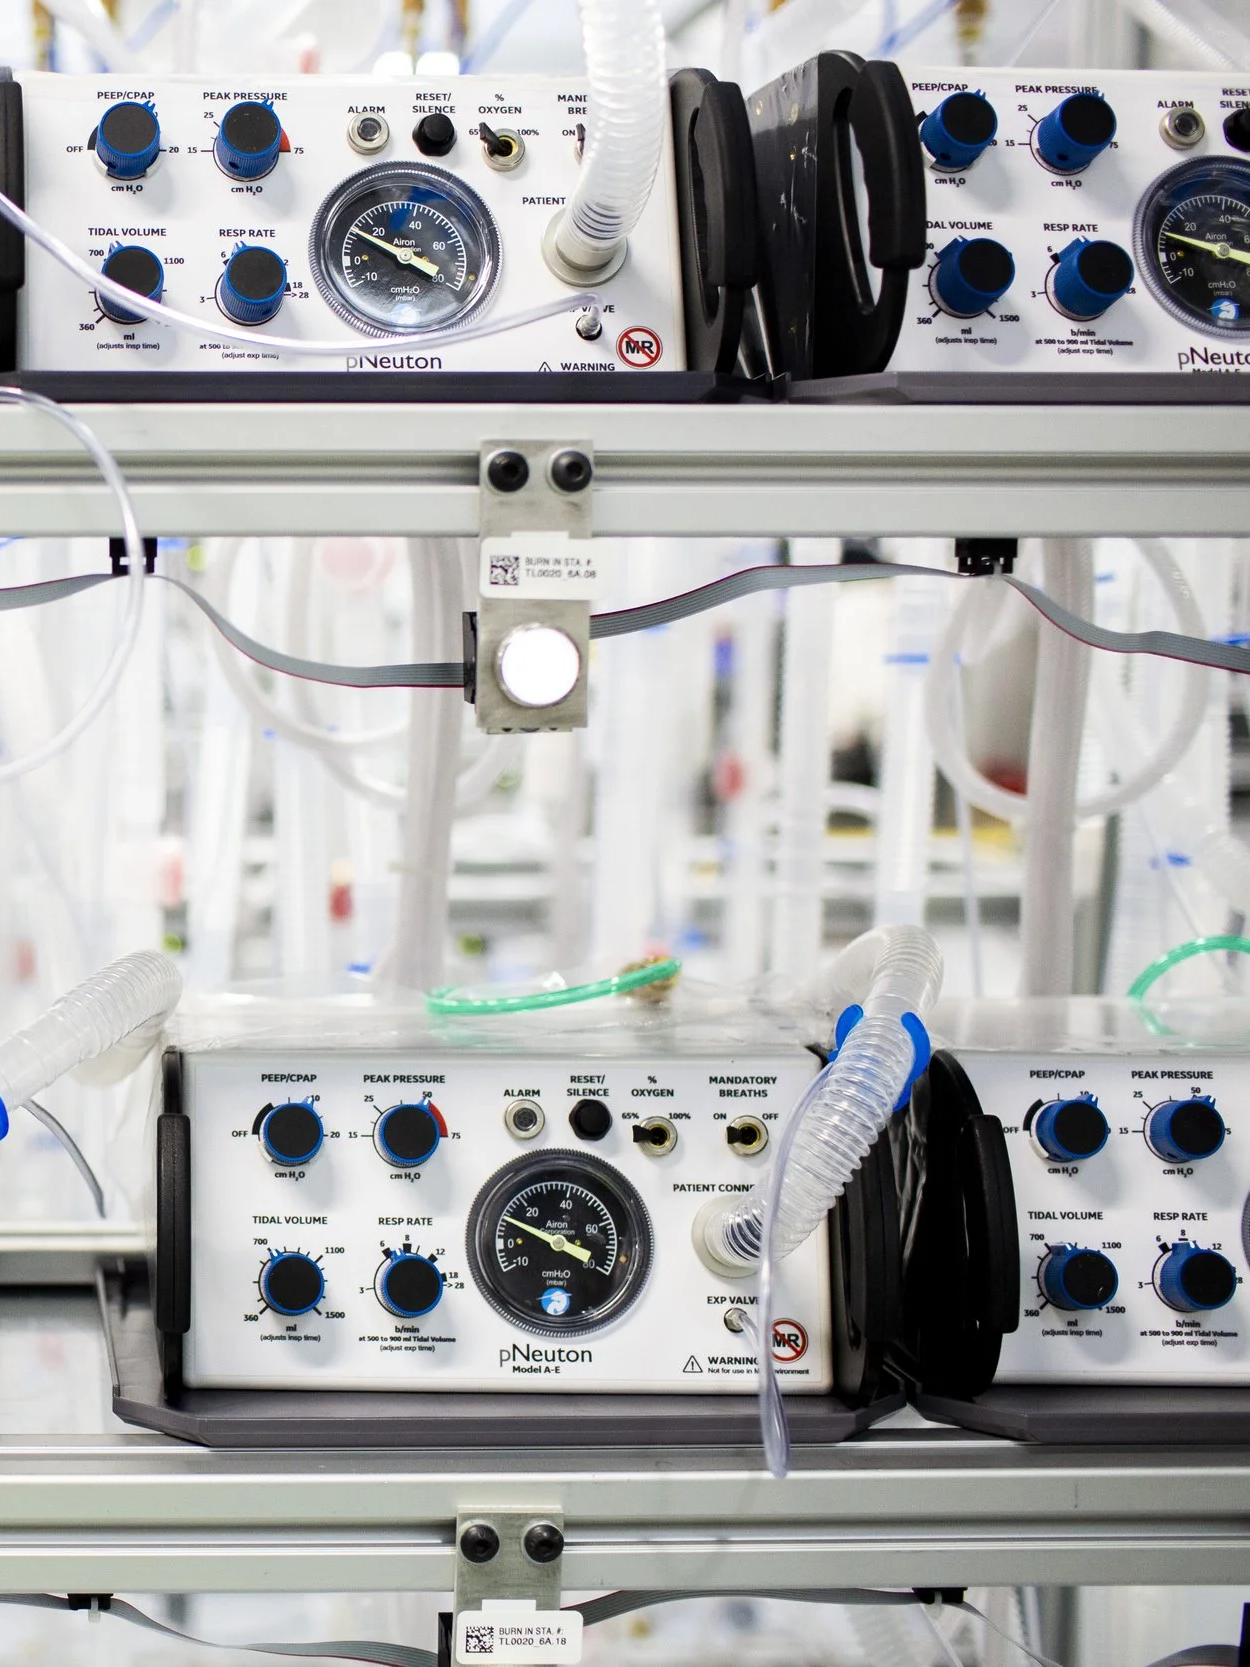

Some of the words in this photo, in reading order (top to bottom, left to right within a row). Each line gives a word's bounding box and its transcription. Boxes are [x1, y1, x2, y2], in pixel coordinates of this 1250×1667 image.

[912, 83, 968, 91] PEEP/CPAP
[1015, 85, 1042, 93] PEAK
[98, 92, 154, 100] PEEP/CPAP
[416, 93, 451, 102] RESET/
[479, 106, 521, 114] OXYGEN
[523, 197, 565, 205] PATIENT
[409, 221, 421, 229] 40
[949, 221, 992, 230] VOLUME
[1044, 223, 1070, 232] RESP
[1073, 224, 1098, 232] RATE
[1185, 223, 1196, 231] 20
[88, 228, 119, 236] TIDAL
[122, 228, 166, 236] VOLUME
[219, 229, 246, 237] RESP
[249, 229, 275, 237] RATE
[373, 228, 385, 236] 20
[433, 242, 445, 250] 60
[626, 341, 654, 354] MR
[561, 363, 615, 371] WARNING
[261, 1074, 316, 1083] PEEP/CPAP
[364, 1075, 390, 1083] PEAK
[393, 1075, 445, 1083] PRESSURE
[1030, 1071, 1085, 1079] PEEP/CPAP
[1132, 1071, 1158, 1079] PEAK
[1161, 1071, 1213, 1079] PRESSURE
[570, 1075, 605, 1084] RESET/
[710, 1076, 777, 1085] MANDATORY
[504, 1089, 540, 1097] ALARM
[567, 1088, 609, 1097] SILENCE
[632, 1089, 674, 1097] OXYGEN
[719, 1090, 768, 1098] BREATHS
[673, 1184, 716, 1192] PATIENT
[560, 1201, 572, 1209] 40
[526, 1208, 538, 1217] 20
[1028, 1212, 1057, 1220] TIDAL
[1060, 1212, 1103, 1220] VOLUME
[253, 1216, 282, 1224] TIDAL
[285, 1216, 327, 1224] VOLUME
[1154, 1213, 1179, 1221] RESP
[1182, 1213, 1208, 1221] RATE
[586, 1225, 597, 1233] 60
[500, 1344, 592, 1367] pNeuton
